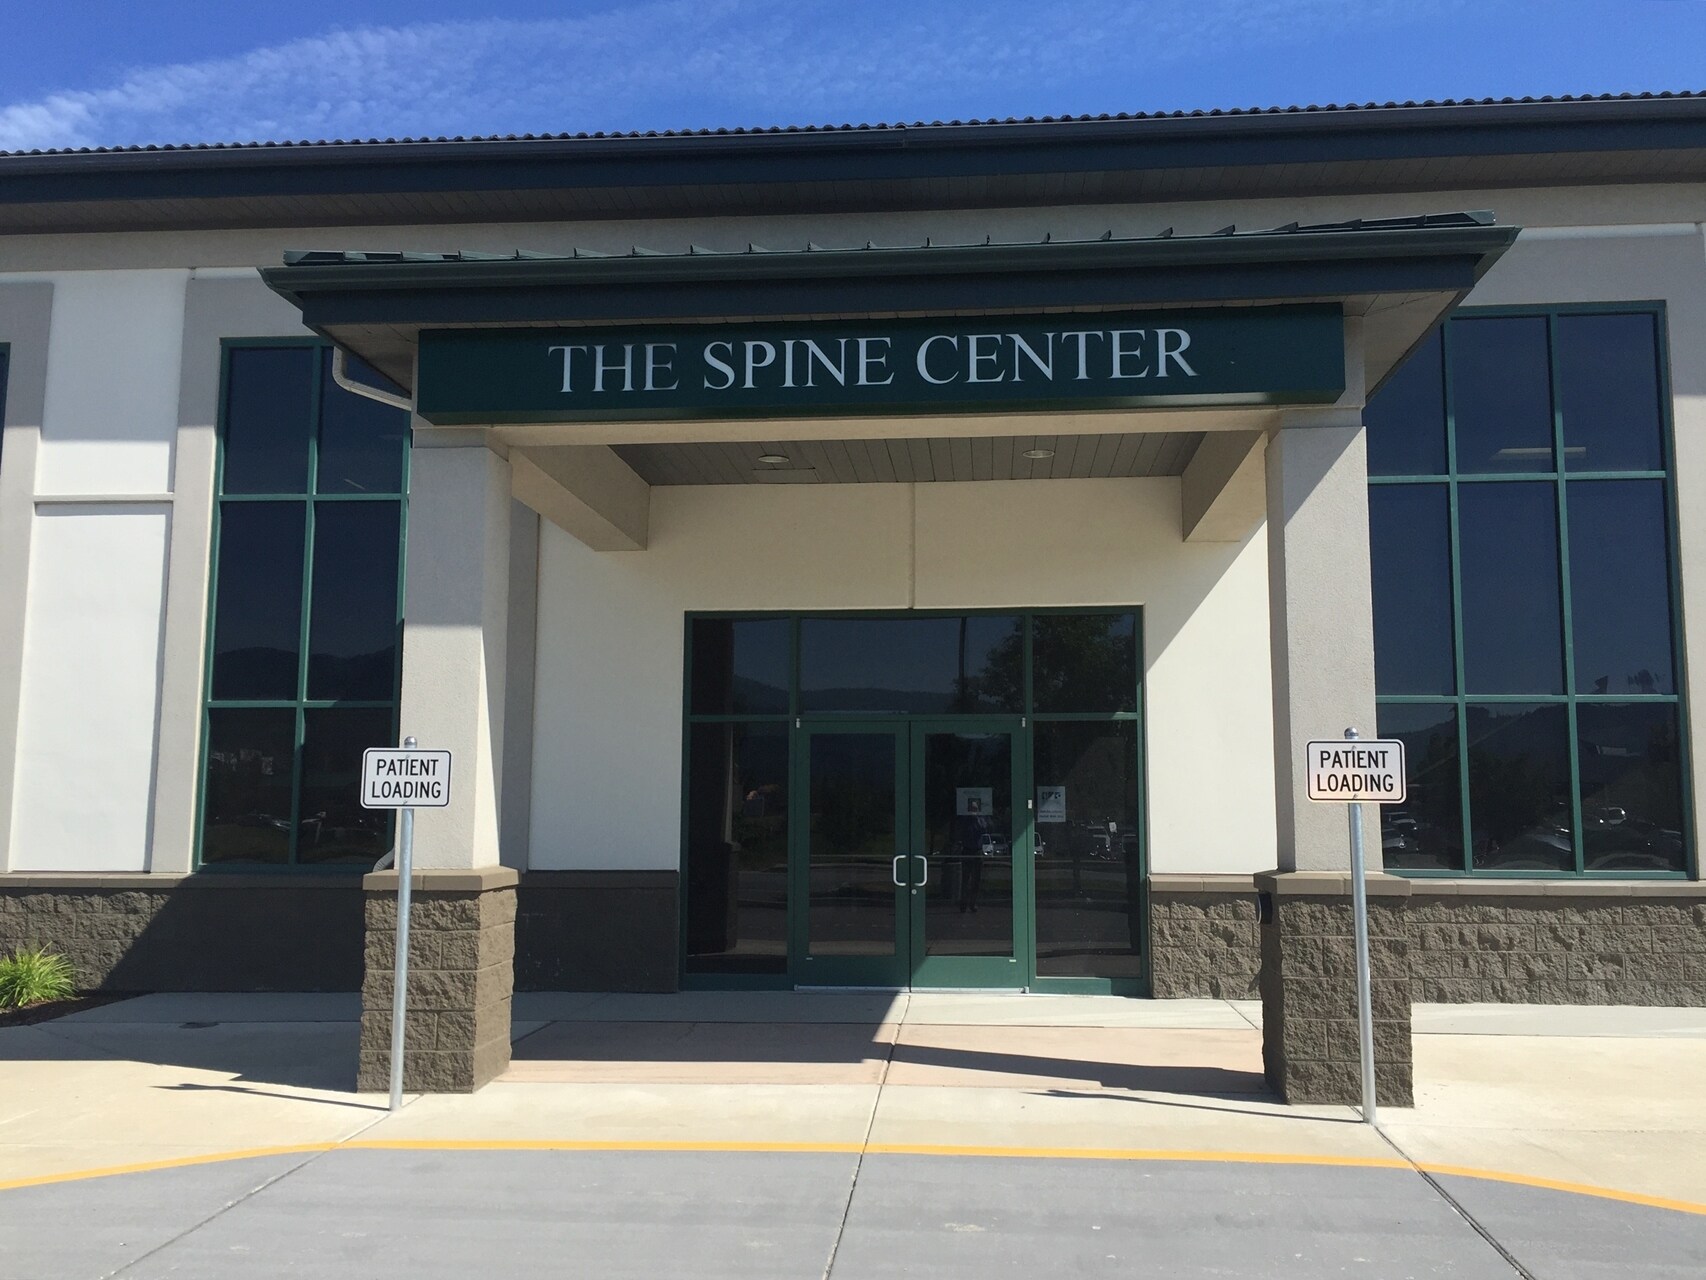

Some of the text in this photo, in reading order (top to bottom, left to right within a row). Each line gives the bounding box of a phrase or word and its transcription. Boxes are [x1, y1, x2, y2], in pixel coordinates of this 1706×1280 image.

[547, 328, 1199, 392] THE SPINE CENTER
[376, 758, 440, 776] PATIENT
[1319, 750, 1389, 769] PATIENT
[371, 780, 442, 799] LOADING
[1316, 773, 1394, 792] LOADING
